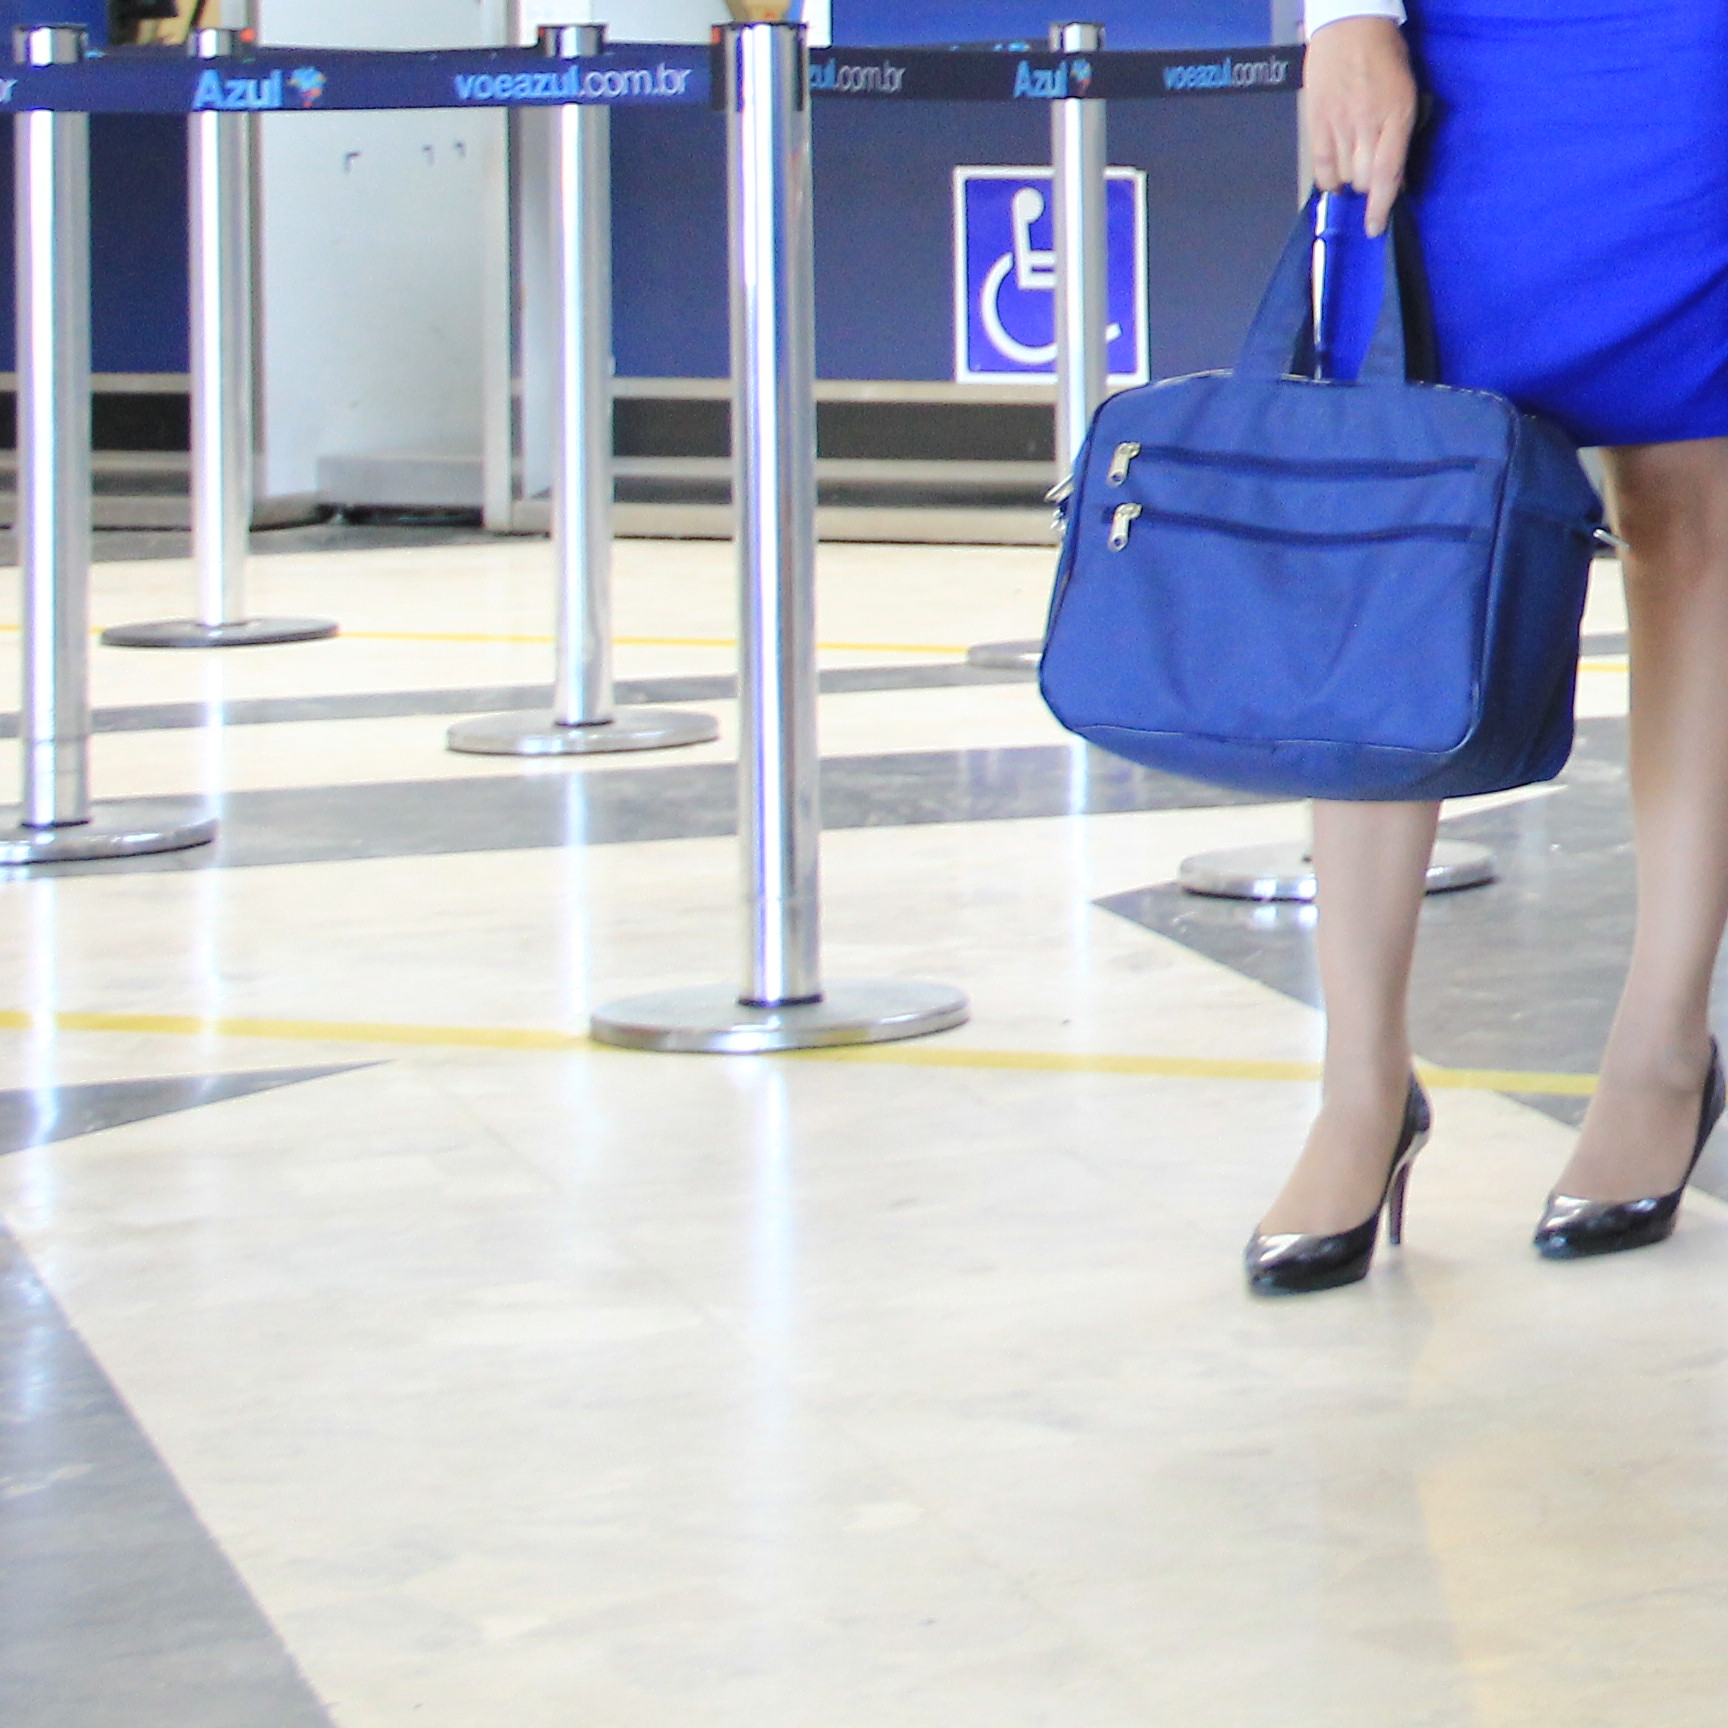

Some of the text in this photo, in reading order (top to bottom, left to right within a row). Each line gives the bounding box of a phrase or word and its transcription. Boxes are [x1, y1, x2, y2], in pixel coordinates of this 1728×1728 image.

[191, 68, 284, 111] Azul
[453, 62, 693, 101] voeazul.com.br
[1012, 58, 1068, 100] Azul
